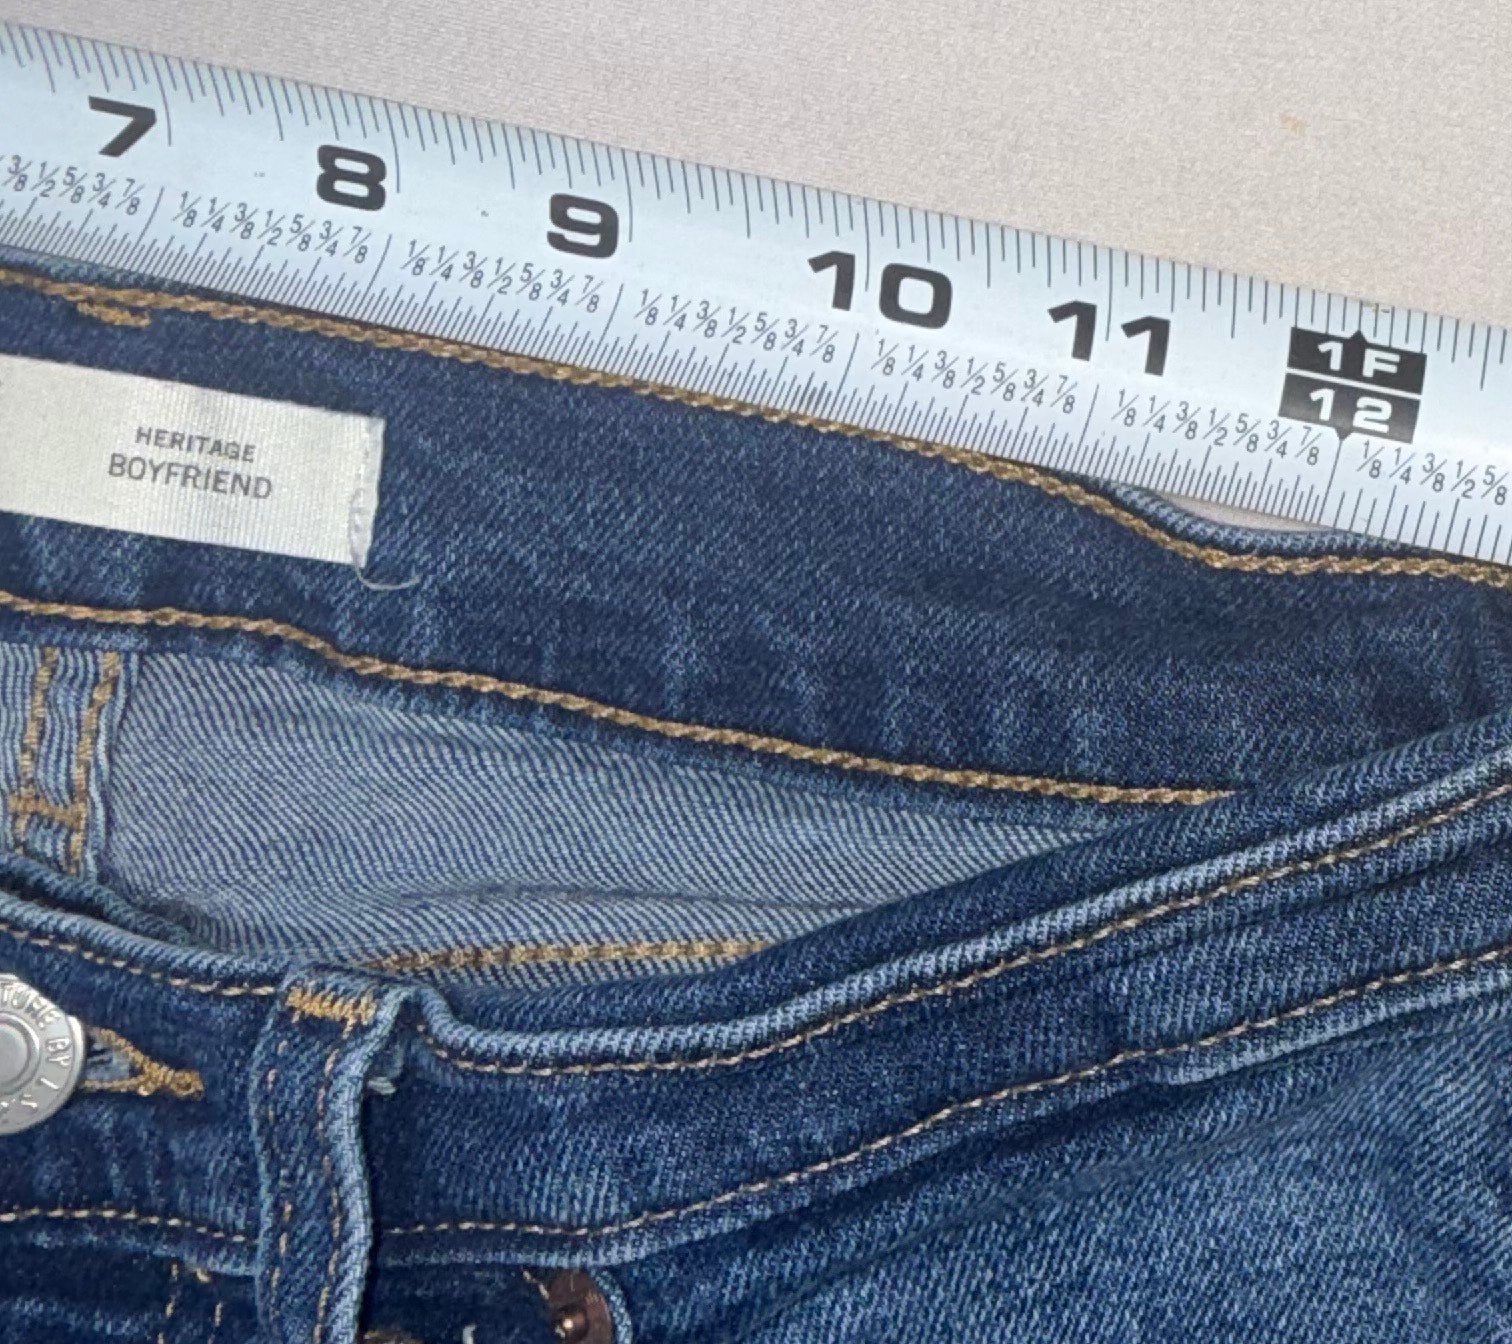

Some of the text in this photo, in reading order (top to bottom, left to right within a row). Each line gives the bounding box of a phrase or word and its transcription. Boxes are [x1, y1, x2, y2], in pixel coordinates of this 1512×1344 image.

[88, 96, 156, 157] 7
[317, 145, 386, 211] 8
[547, 193, 619, 259] 9
[808, 250, 952, 329] 10
[1047, 300, 1171, 376] 11
[1318, 341, 1400, 378] 1F
[1310, 388, 1393, 433] 12
[135, 426, 256, 463] HERITAGE
[108, 452, 272, 500] BOYFRIEND
